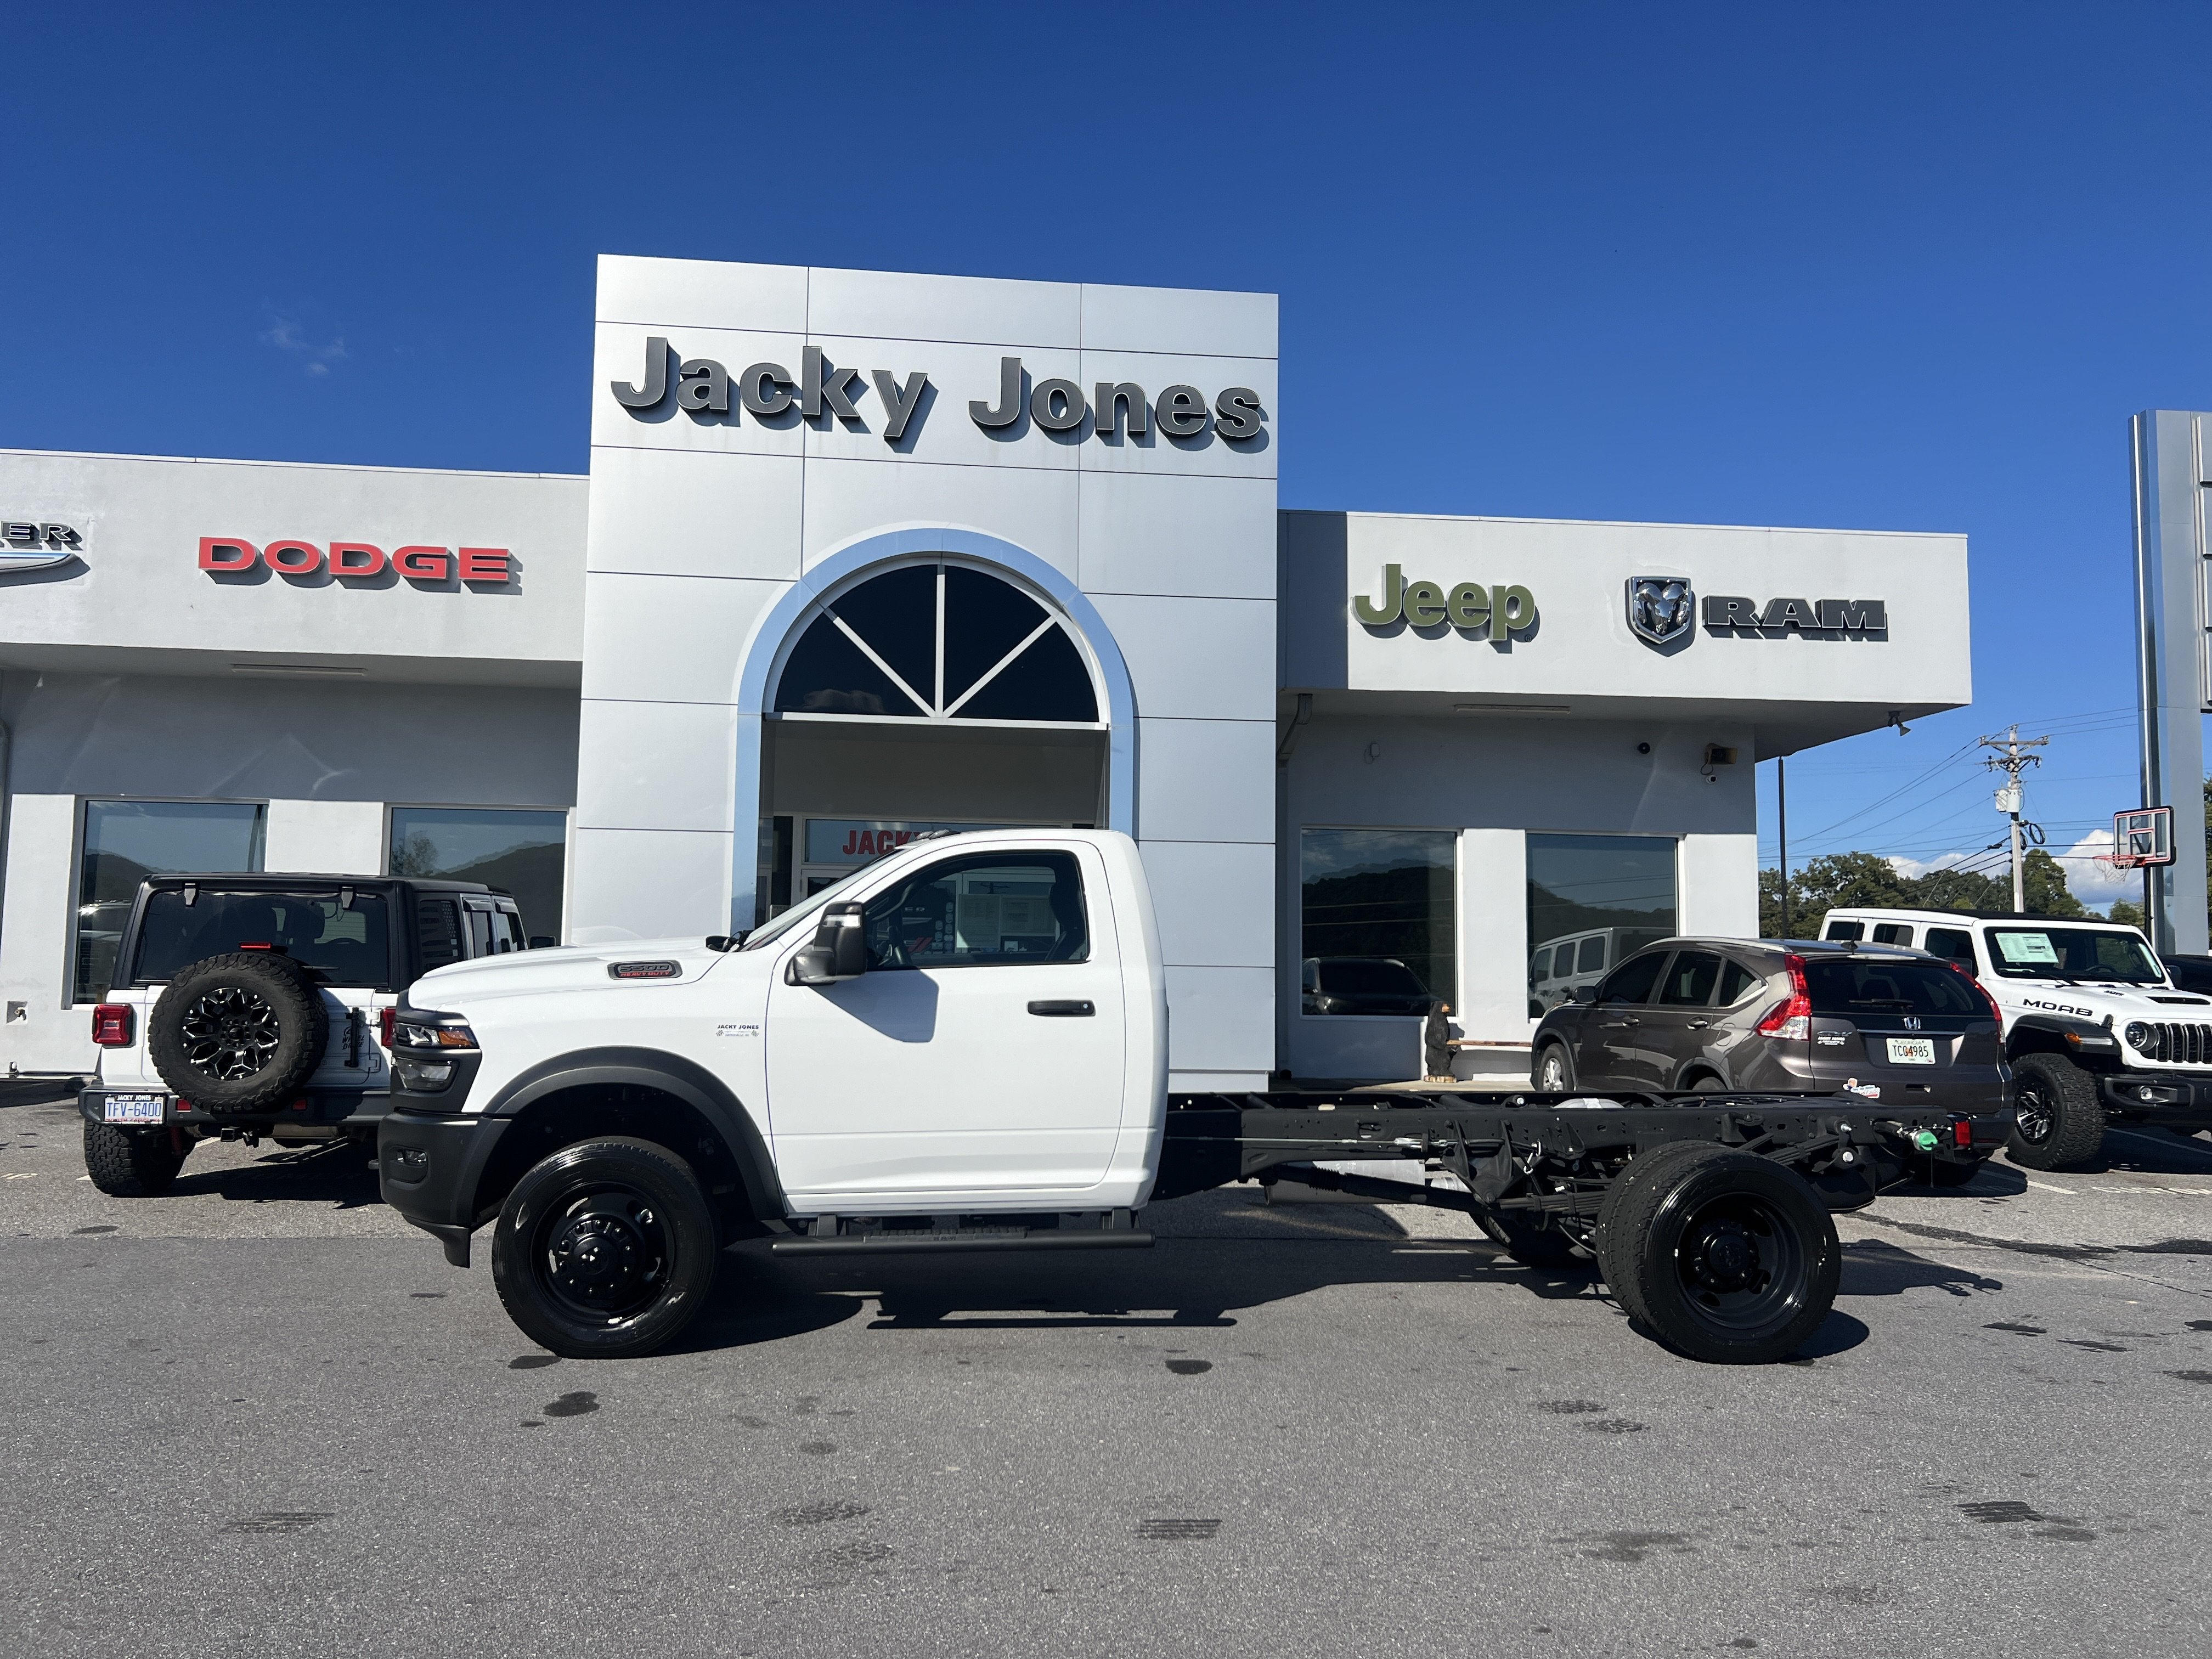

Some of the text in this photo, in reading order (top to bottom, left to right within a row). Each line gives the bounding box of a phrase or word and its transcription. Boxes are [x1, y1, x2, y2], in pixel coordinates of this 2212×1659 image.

[610, 336, 1263, 441] Jacky Jones
[199, 536, 509, 583] DODGE
[1351, 563, 1536, 642] Jeep
[1702, 595, 1887, 630] RAM
[842, 830, 923, 855] JACK
[2022, 998, 2094, 1017] MOAB
[106, 1102, 162, 1116] TFV-6400
